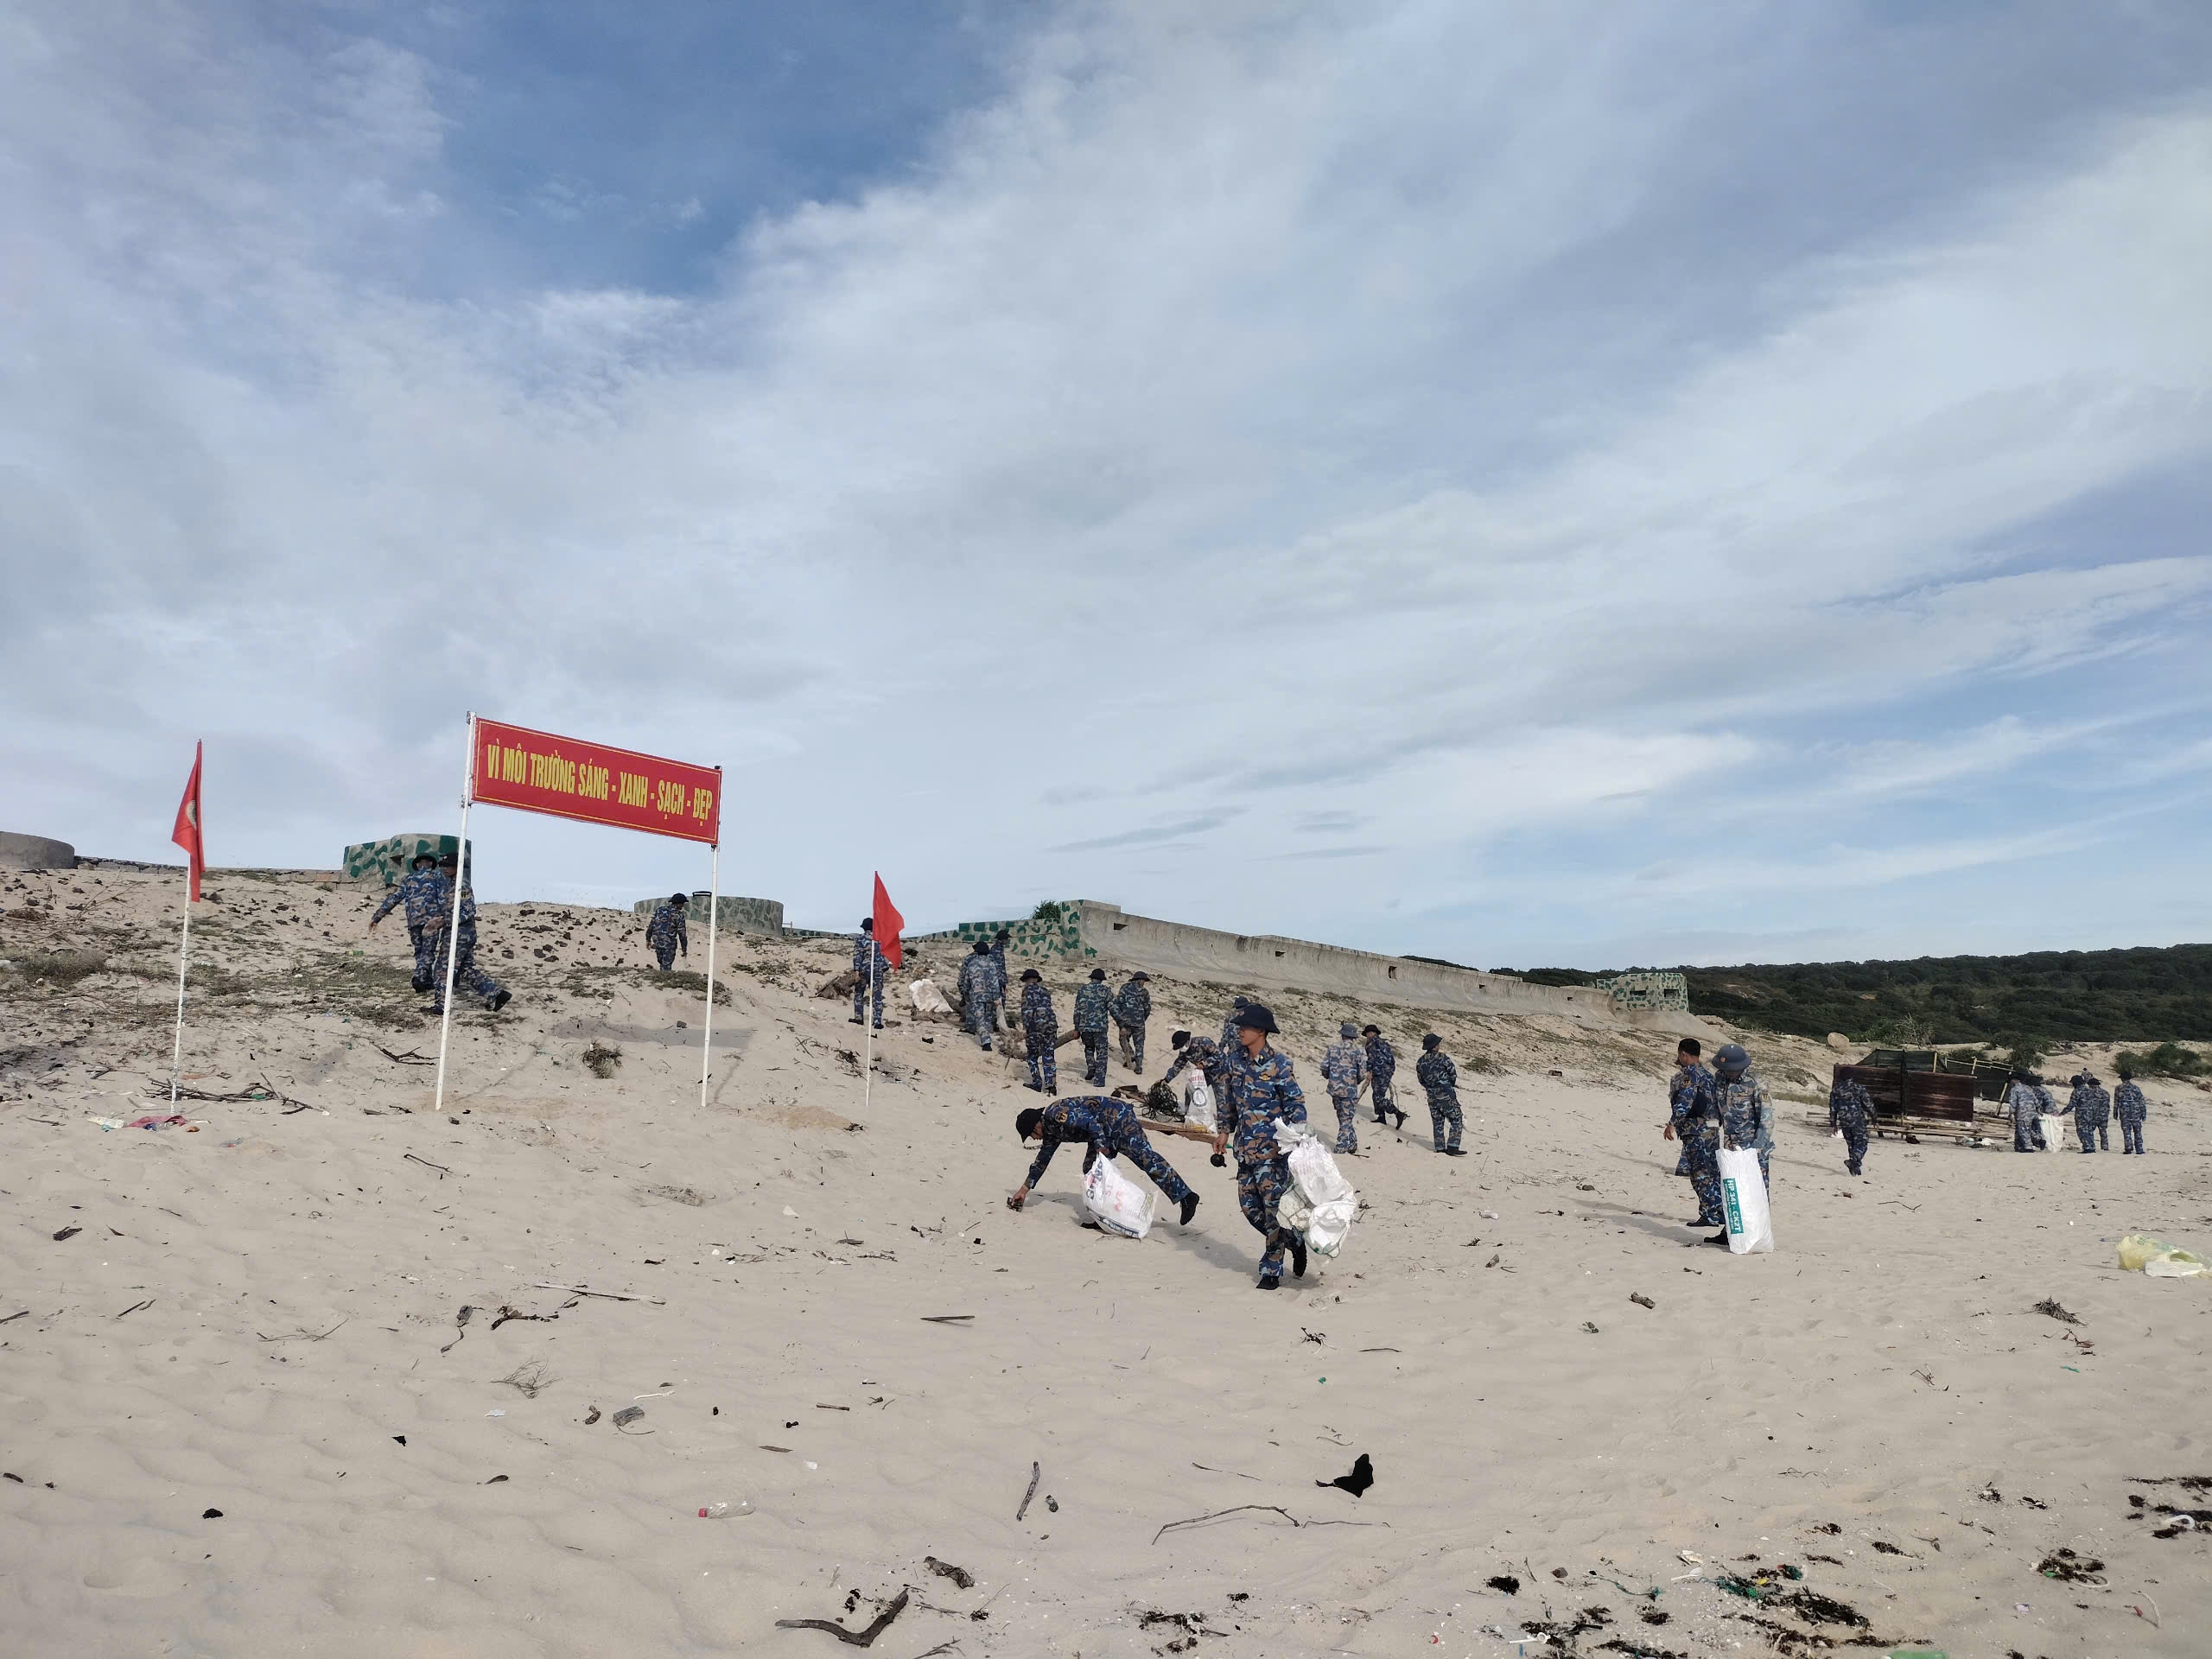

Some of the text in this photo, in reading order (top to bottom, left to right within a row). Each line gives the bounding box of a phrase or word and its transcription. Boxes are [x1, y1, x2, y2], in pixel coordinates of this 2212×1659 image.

[487, 739, 499, 779] VÌ
[503, 743, 526, 785] MÔI
[530, 749, 575, 794] TRƯỜNG
[578, 759, 608, 801] SÁNG
[618, 771, 648, 808] XANH
[657, 779, 685, 820] SẠCH
[692, 787, 713, 827] ĐẸP
[1727, 1179, 1734, 1191] HP
